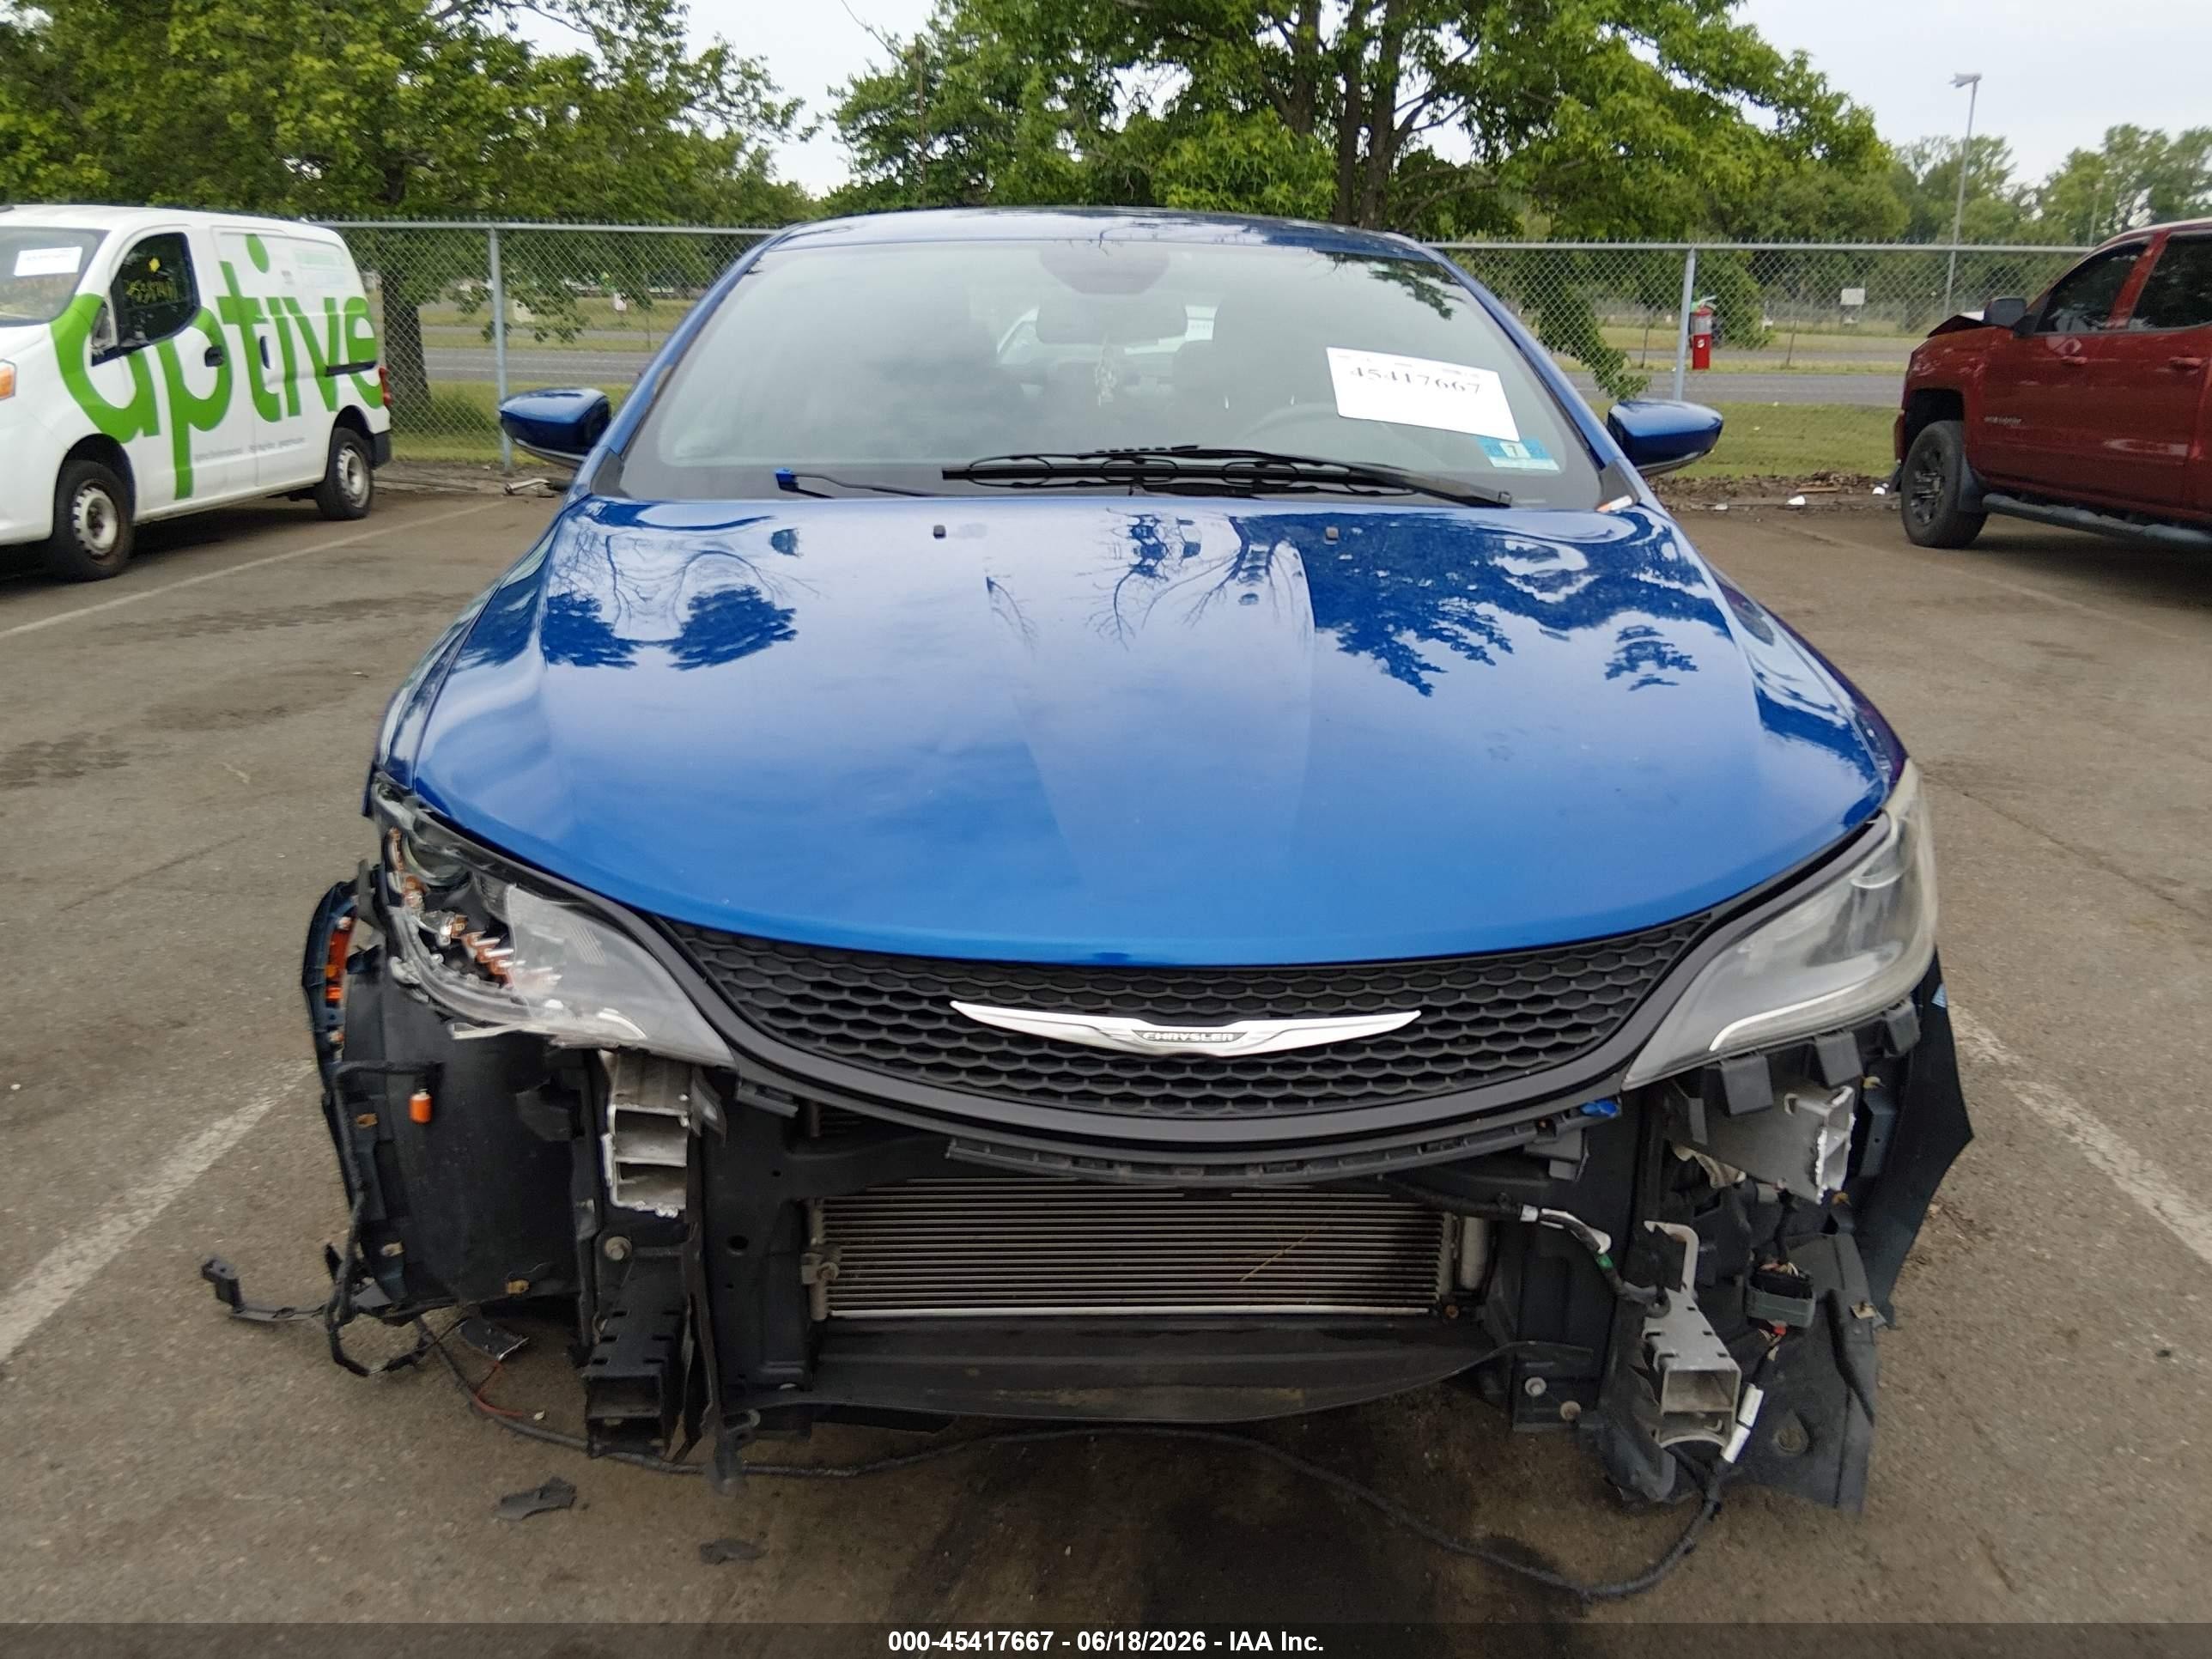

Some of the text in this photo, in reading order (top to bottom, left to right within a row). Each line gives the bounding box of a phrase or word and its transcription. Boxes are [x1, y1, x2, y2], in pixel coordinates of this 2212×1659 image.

[50, 234, 383, 501] aptive
[1350, 367, 1480, 394] 45417667
[1142, 1031, 1234, 1042] CHRYSLER
